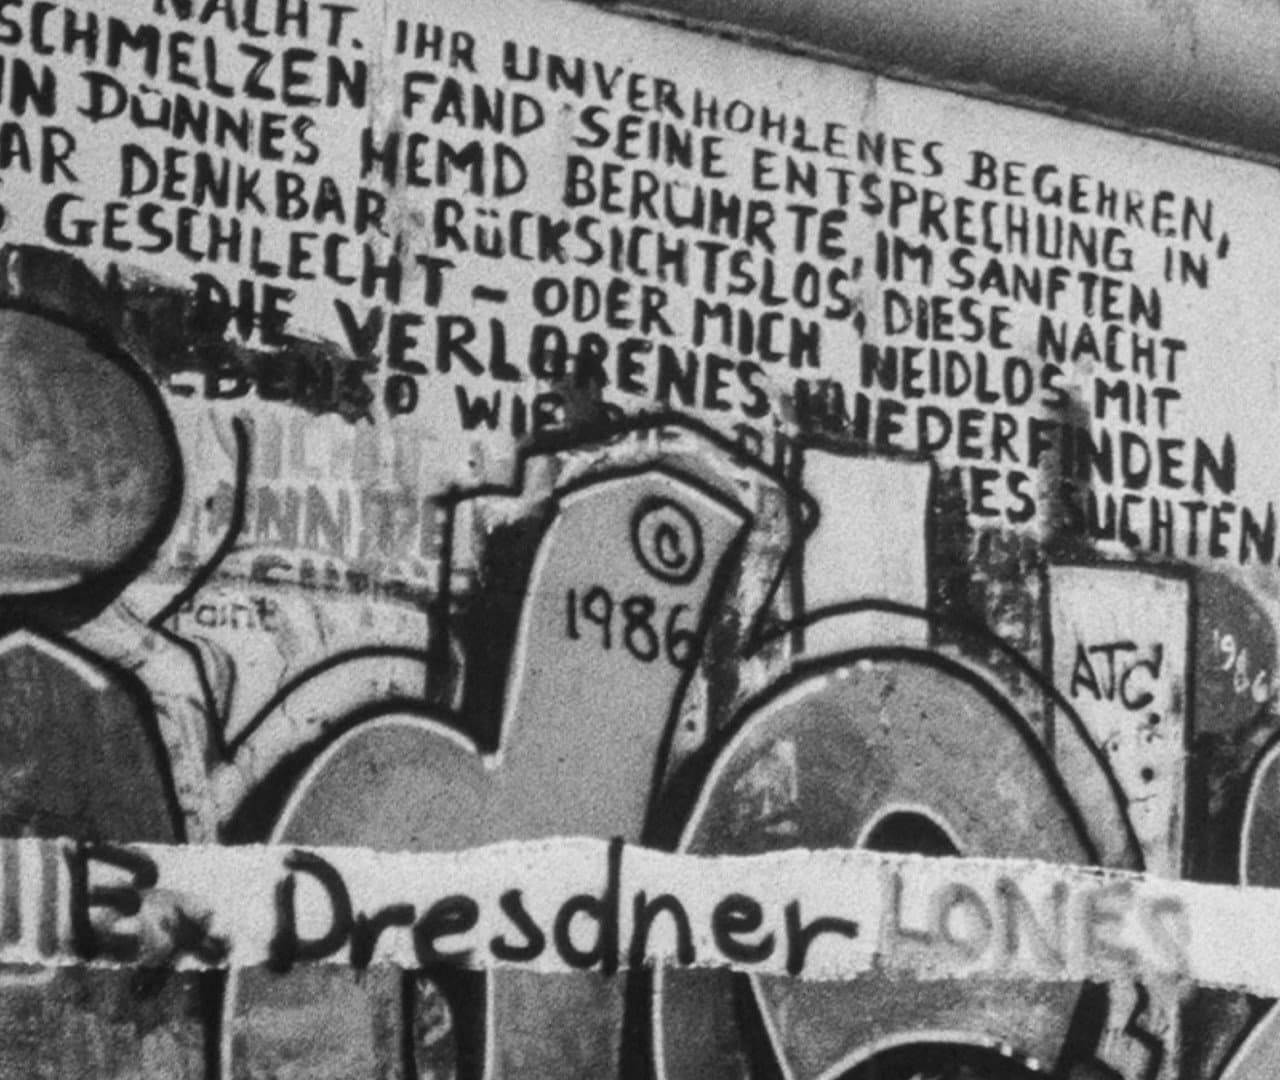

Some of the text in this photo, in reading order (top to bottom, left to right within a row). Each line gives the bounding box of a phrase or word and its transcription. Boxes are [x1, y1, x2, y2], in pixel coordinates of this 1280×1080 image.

[0, 0, 1210, 289] SCHMELZEN FAND SEINE ENTSPRECHUNG IN
[76, 70, 320, 165] DÜNNES
[360, 127, 527, 197] HEMD
[875, 230, 933, 284] IM
[947, 248, 1163, 330] SANFTEN
[394, 20, 476, 73] IHR
[503, 41, 943, 177] UNVERHOHLENES
[965, 150, 1231, 260] BEGEHREN,
[45, 192, 455, 306] GESCHLECHT
[532, 275, 674, 335] ODER
[694, 298, 820, 369] MICH
[860, 343, 1071, 407] NEIDLOS
[1094, 380, 1182, 430] MIT
[120, 143, 390, 237] DENKBAR
[883, 288, 1013, 351] DIESE
[1036, 316, 1188, 382] NACHT
[334, 299, 772, 419] VERLORENES
[456, 385, 566, 438] WIE
[969, 464, 1037, 524] ES
[566, 586, 698, 669] 1986
[269, 836, 858, 976] Dresdner
